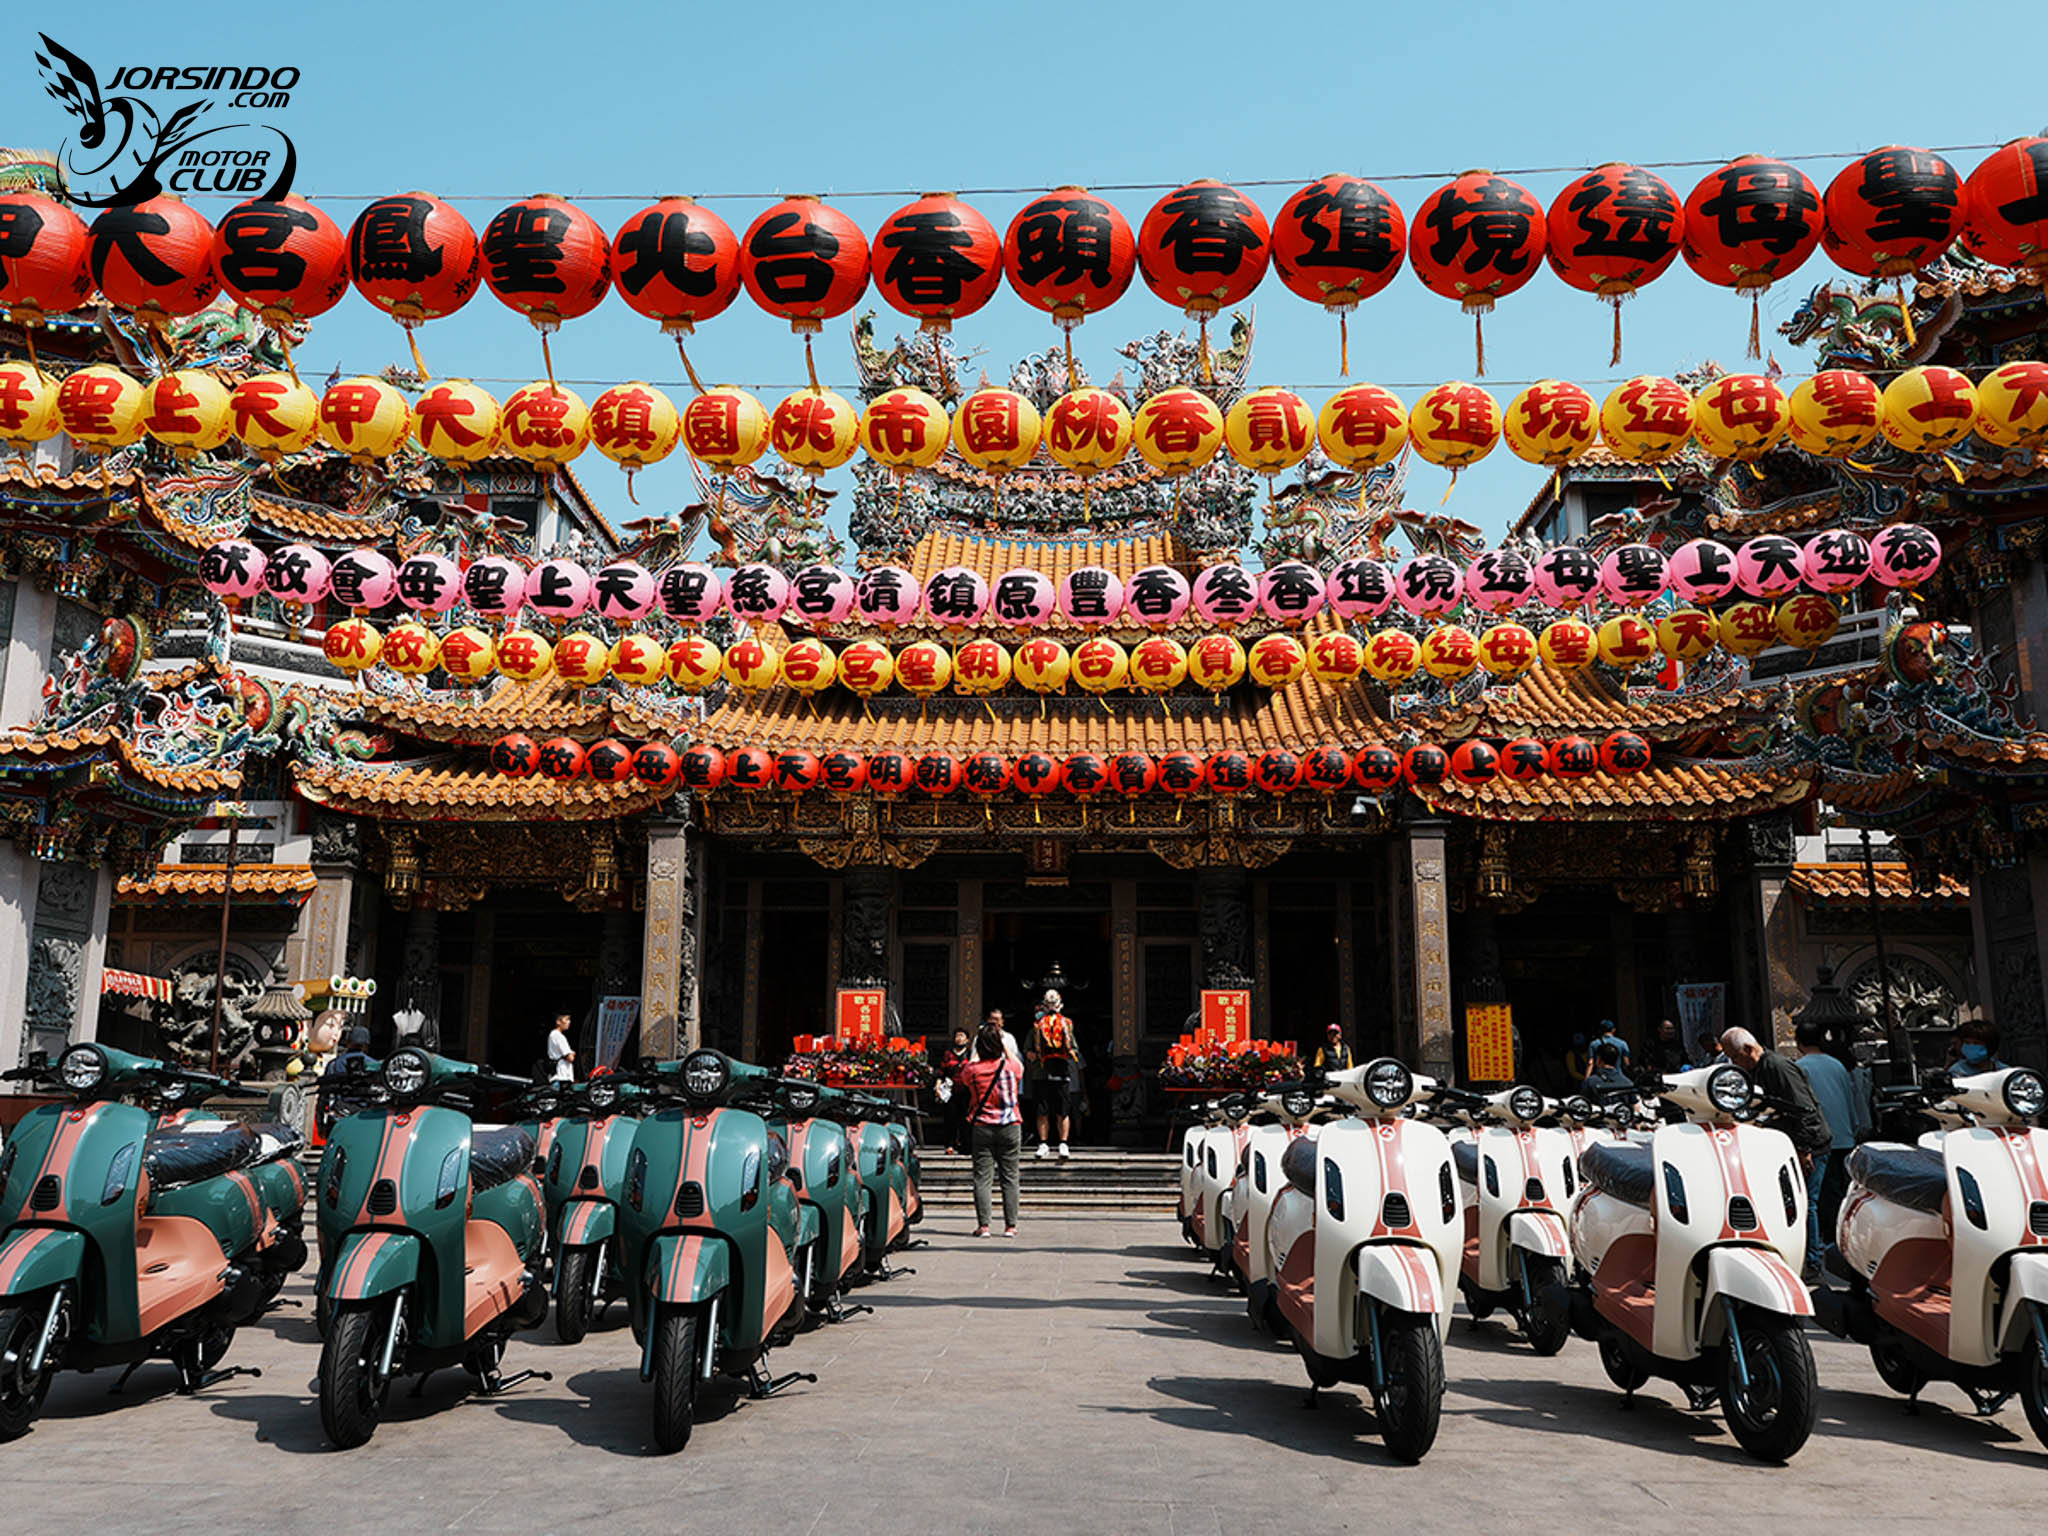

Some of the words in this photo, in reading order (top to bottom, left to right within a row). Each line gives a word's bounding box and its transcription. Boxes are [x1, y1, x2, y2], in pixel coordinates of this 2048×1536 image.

[91, 197, 186, 290] 大
[220, 196, 319, 293] 宮
[351, 197, 444, 284] 鳳
[482, 205, 573, 295] 聖
[618, 212, 718, 298] 北
[749, 212, 841, 306] 台
[883, 210, 986, 306] 香
[1017, 198, 1113, 289] 頭
[1159, 187, 1265, 276] 香
[1293, 181, 1401, 274] 進
[1425, 178, 1535, 276] 境
[1700, 165, 1818, 257] 母
[1857, 154, 1957, 244] 聖
[58, 374, 124, 435] 聖
[144, 376, 203, 435] 上
[232, 381, 297, 439] 天
[321, 385, 381, 446] 甲
[415, 387, 485, 449] 大
[503, 382, 576, 449] 德
[591, 388, 657, 452] 鎮
[684, 395, 741, 457] 園
[772, 397, 836, 454] 桃
[868, 394, 930, 457] 市
[962, 393, 1020, 455] 園
[1050, 394, 1119, 453] 桃
[1145, 393, 1216, 455] 香
[1331, 389, 1403, 448] 香
[1426, 386, 1499, 448] 進
[1520, 384, 1592, 443] 境
[1707, 375, 1783, 436] 母
[1811, 372, 1877, 429] 聖
[1907, 369, 1974, 423] 上
[265, 549, 312, 595] 敬
[331, 557, 379, 604] 會
[396, 560, 447, 605] 母
[463, 564, 509, 611] 聖
[529, 565, 574, 609] 上
[595, 568, 641, 613] 天
[659, 569, 708, 617] 聖
[730, 567, 778, 614] 慈
[793, 566, 842, 615] 宮
[858, 569, 903, 614] 清
[926, 572, 979, 619] 鎮
[995, 575, 1041, 620] 原
[1068, 570, 1110, 618] 豐
[1130, 569, 1182, 617] 香
[1267, 565, 1320, 611] 香
[1335, 561, 1389, 605] 進
[1402, 557, 1456, 602] 境
[1543, 549, 1600, 593] 母
[1615, 547, 1664, 593] 聖
[1684, 543, 1732, 588] 上
[1748, 538, 1801, 585] 天
[1815, 533, 1871, 576] 迎
[1880, 527, 1939, 573] 恭
[383, 629, 426, 668] 敬
[439, 631, 484, 674] 會
[497, 637, 539, 675] 母
[553, 639, 591, 678] 聖
[611, 639, 648, 675] 上
[668, 641, 707, 679] 天
[728, 641, 764, 682] 中
[783, 644, 822, 682] 台
[841, 644, 886, 689] 宮
[897, 647, 937, 687] 聖
[957, 643, 1001, 681] 朝
[1020, 641, 1059, 676] 中
[1078, 641, 1116, 678] 台
[1137, 640, 1181, 678] 香
[1255, 638, 1301, 677] 香
[1313, 636, 1361, 675] 進
[1372, 633, 1415, 673] 境
[1483, 628, 1533, 669] 母
[1548, 624, 1591, 665] 聖
[1608, 619, 1651, 658] 上
[1670, 613, 1715, 652] 天
[1730, 605, 1777, 643] 迎
[1789, 597, 1836, 634] 恭
[539, 745, 576, 778] 敬
[587, 745, 625, 782] 會
[633, 749, 671, 784] 母
[680, 752, 713, 786] 聖
[729, 753, 761, 785] 上
[777, 755, 811, 785] 天
[822, 753, 859, 789] 宮
[869, 754, 903, 786] 明
[917, 755, 952, 789] 朝
[1018, 754, 1052, 789] 中
[1066, 755, 1105, 790] 香
[1161, 755, 1199, 789] 香
[1211, 754, 1249, 788] 進
[1260, 751, 1297, 787] 境
[1358, 749, 1399, 783] 母
[1410, 749, 1446, 785] 聖
[1461, 746, 1496, 778] 上
[1511, 743, 1545, 776] 天
[1556, 742, 1595, 774] 迎
[1610, 735, 1649, 769] 恭
